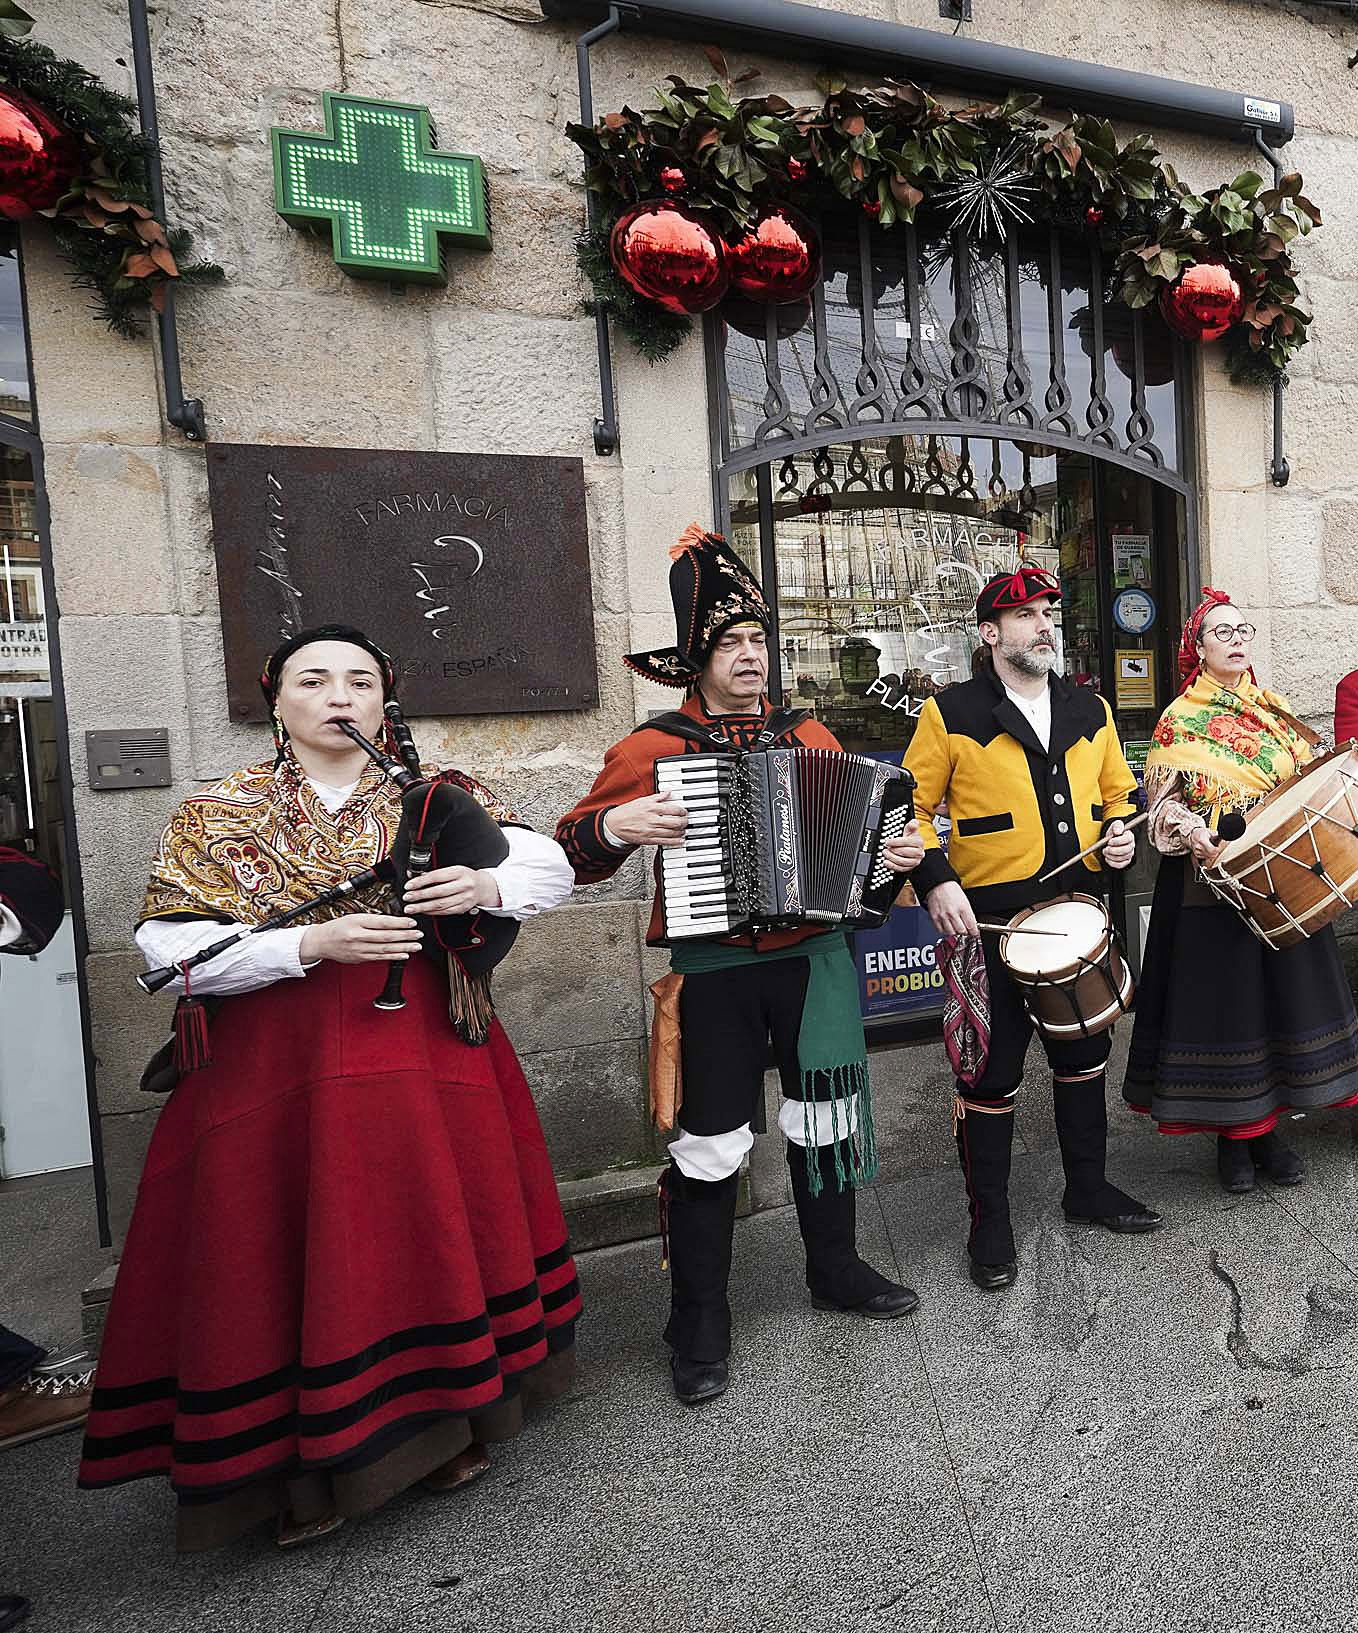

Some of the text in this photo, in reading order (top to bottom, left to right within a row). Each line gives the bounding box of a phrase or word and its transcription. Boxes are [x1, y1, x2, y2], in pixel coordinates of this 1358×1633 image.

[353, 491, 512, 526] FARMACIA
[873, 528, 1019, 567] FARMACIA
[0, 629, 46, 642] NTRAD
[1, 646, 42, 658] OTRA
[865, 678, 926, 718] PLAZ
[865, 944, 937, 974] ENERG
[866, 968, 945, 997] PROBIÓ
